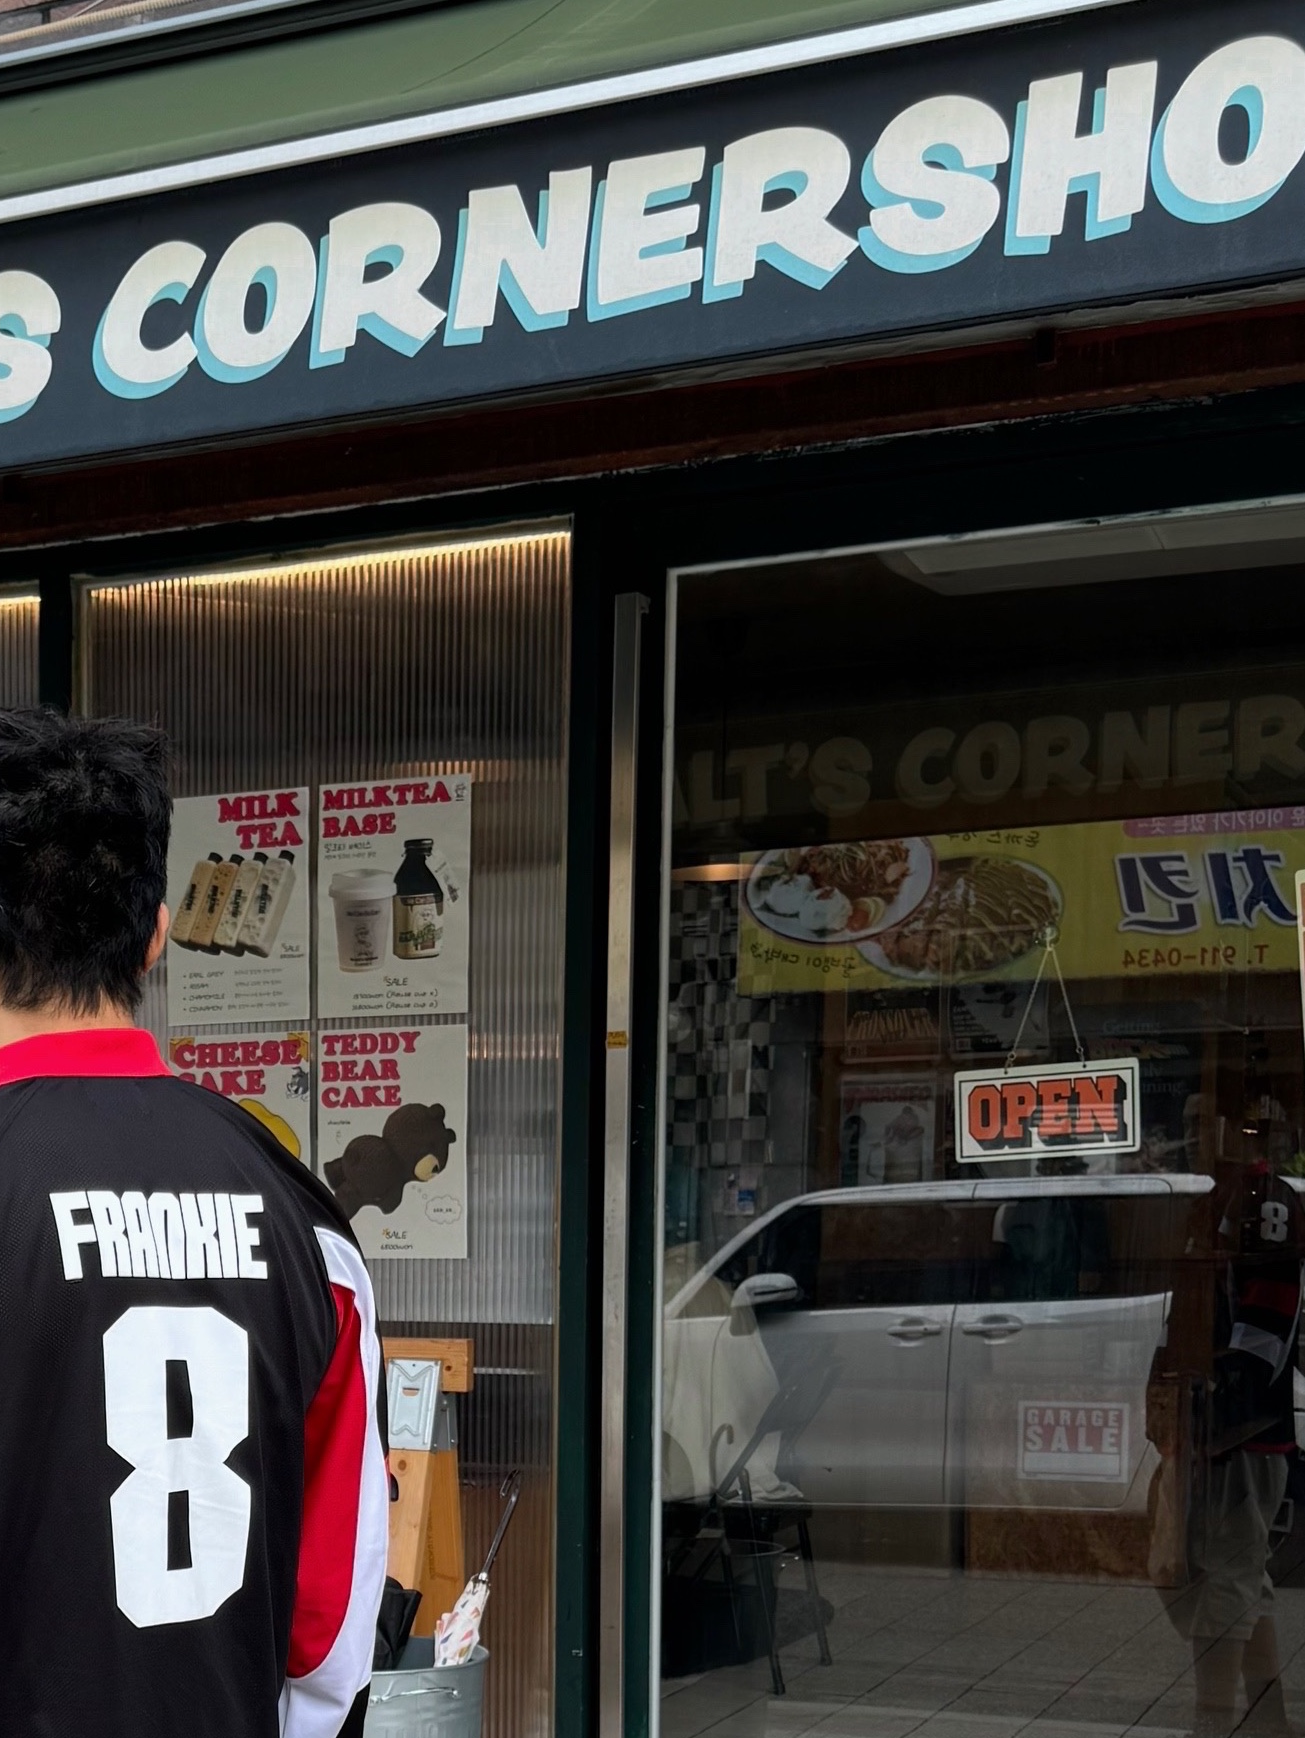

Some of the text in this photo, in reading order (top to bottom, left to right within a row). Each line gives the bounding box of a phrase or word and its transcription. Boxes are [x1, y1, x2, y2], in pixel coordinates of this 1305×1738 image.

[92, 35, 1305, 400] CORNERSHO
[674, 737, 872, 824] LT'S
[217, 791, 301, 824] MILK
[323, 781, 452, 811] MILKTEA
[236, 820, 304, 850] TEA
[322, 812, 396, 839] BASE
[173, 1040, 302, 1069] CHEESE
[321, 1031, 421, 1056] TEDDY
[321, 1059, 401, 1082] BEAR
[320, 1085, 402, 1109] CAKE
[967, 1073, 1127, 1150] OPEN
[48, 1190, 268, 1282] FRANKIE
[1026, 1408, 1120, 1427] GARAGE
[1025, 1425, 1120, 1453] SALE
[102, 1306, 252, 1629] 8
